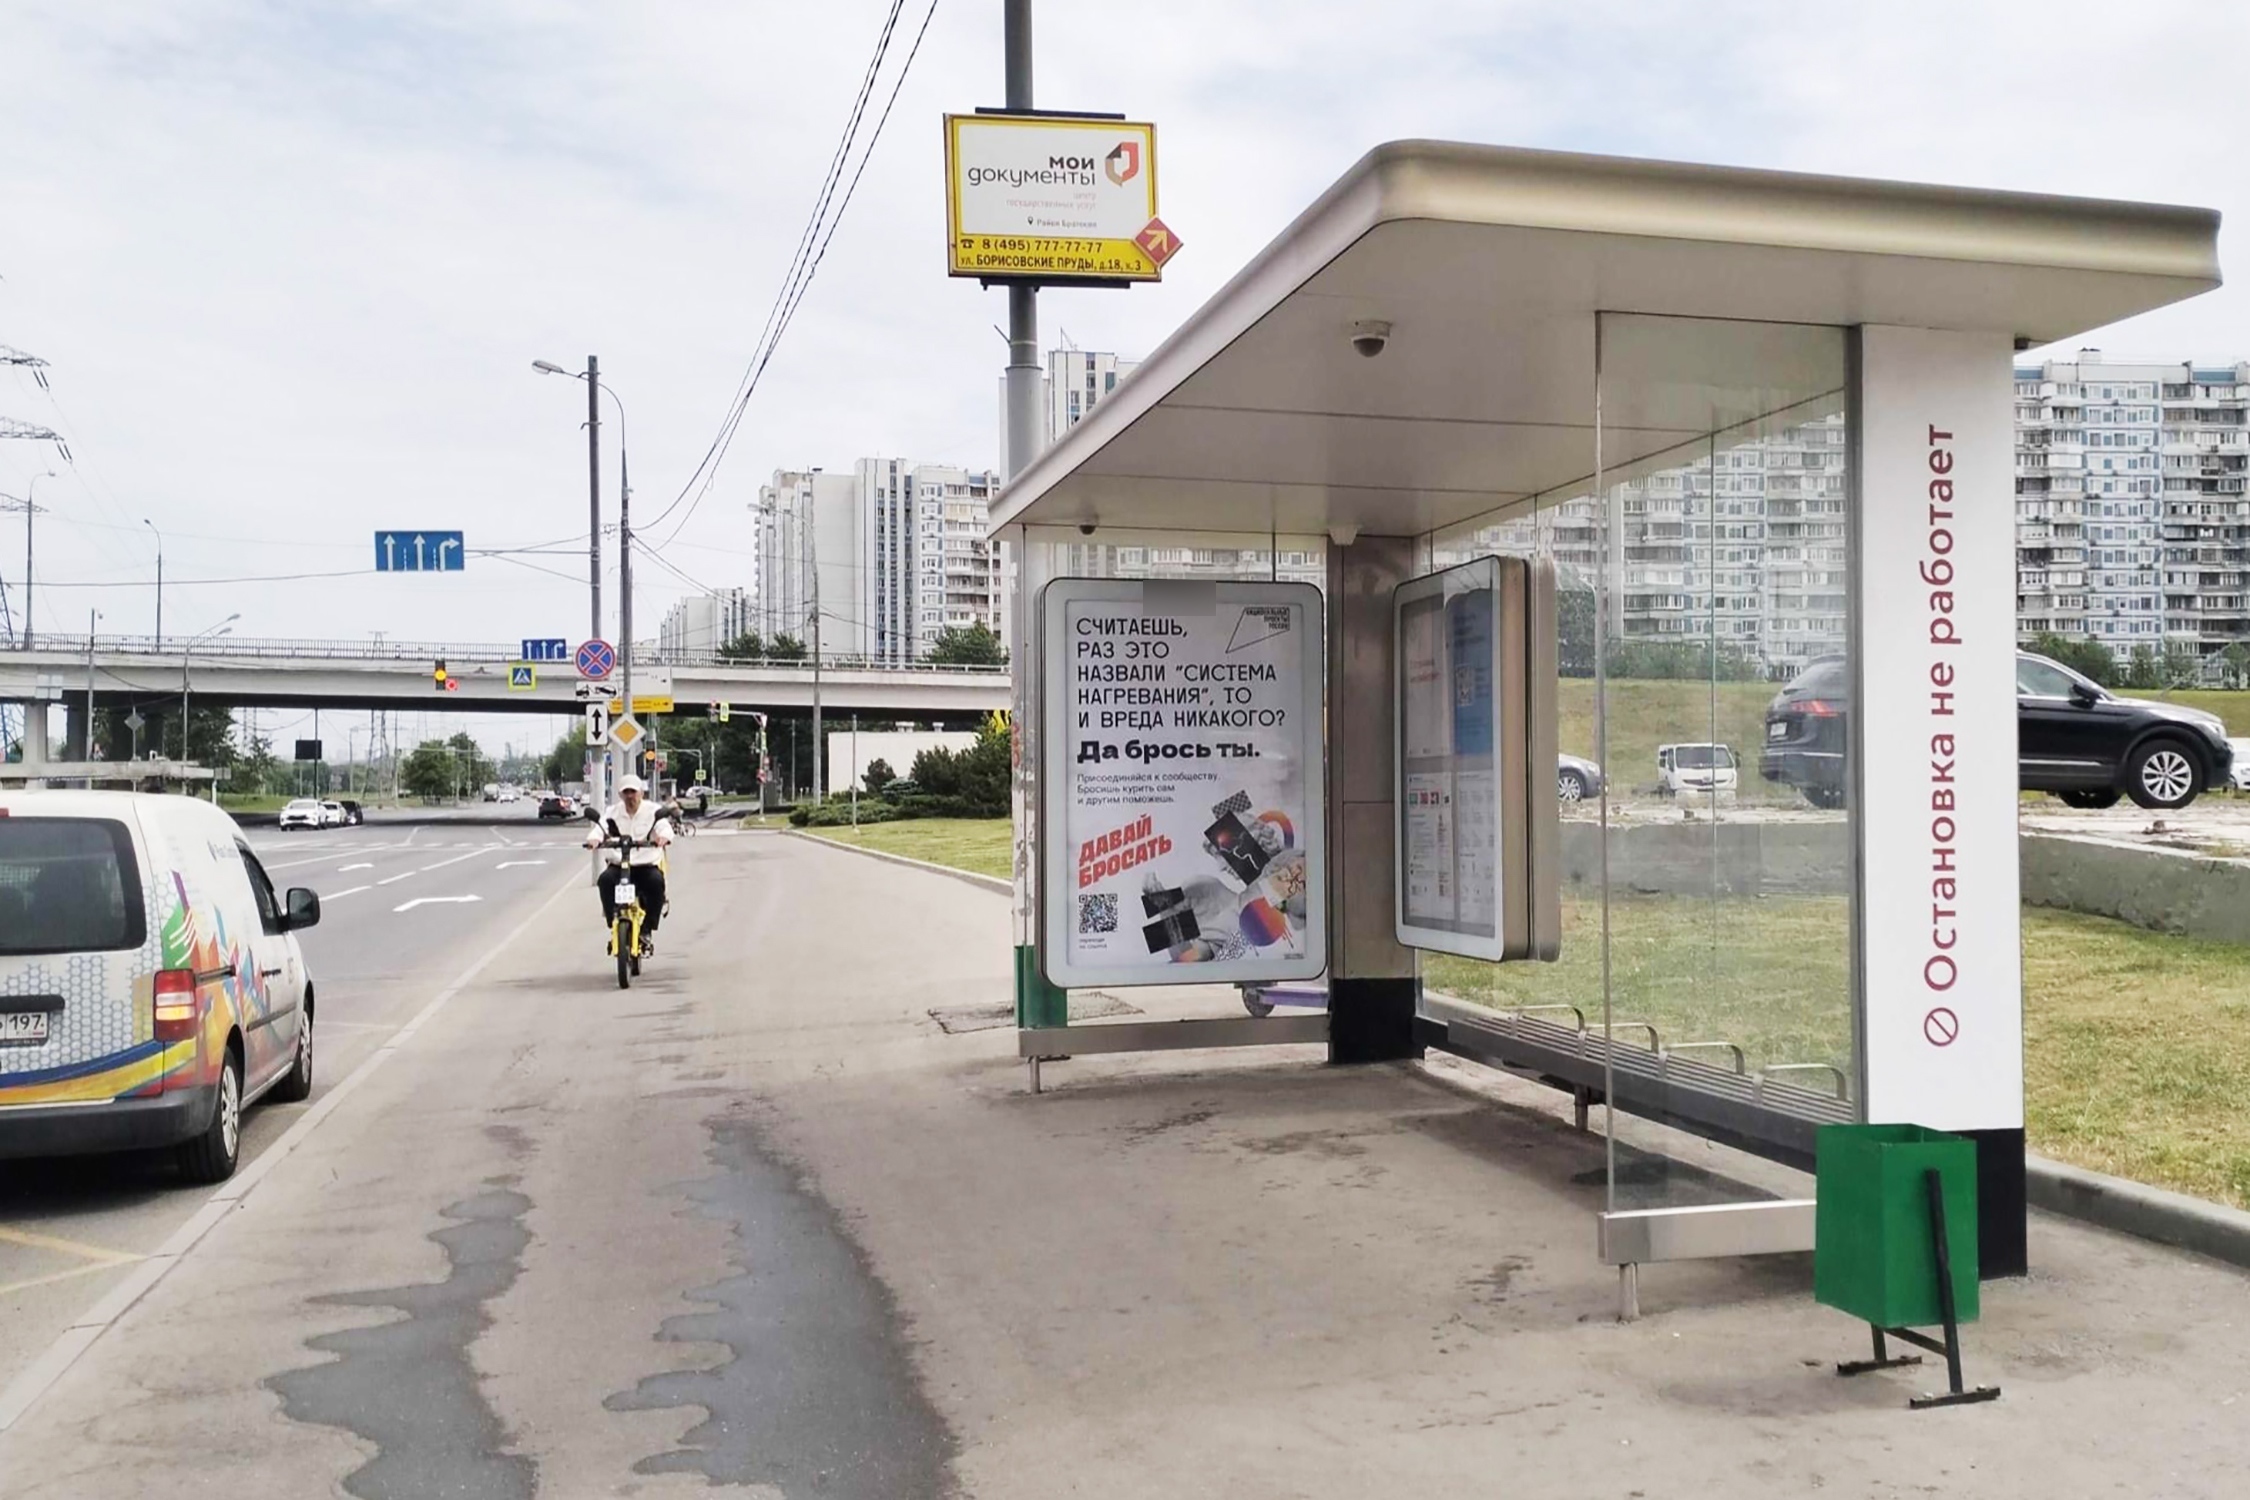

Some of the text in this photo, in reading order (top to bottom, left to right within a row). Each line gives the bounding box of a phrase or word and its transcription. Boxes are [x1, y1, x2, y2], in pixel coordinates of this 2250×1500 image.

[1050, 155, 1095, 170] мои
[968, 166, 1096, 188] документы
[983, 239, 1103, 253] 8 (495) 777-77-77
[961, 257, 974, 266] ул.
[976, 254, 1054, 268] БОРИСОВСКИЕ
[1057, 257, 1097, 271] ПРУДЫ,
[1076, 617, 1188, 638] СЧИТАЕШЬ,
[1077, 641, 1170, 659] РАЗ ЭТО
[1077, 664, 1166, 682] НАЗВАЛИ
[1223, 687, 1252, 704] ТО
[1919, 424, 1963, 992] Остановка не работает
[1078, 709, 1286, 731] И ВРЕДА НИКАКОГО?
[1077, 739, 1261, 764] Да брось ты.
[1077, 773, 1153, 784] Присоединяйся
[1154, 774, 1161, 782] к
[1077, 784, 1175, 795] Бросишь курить сам
[1086, 796, 1120, 806] другим
[1078, 813, 1153, 867] ДАВАЙ
[1078, 834, 1173, 889] БРОСАТЬ
[9, 1014, 42, 1031] 197
